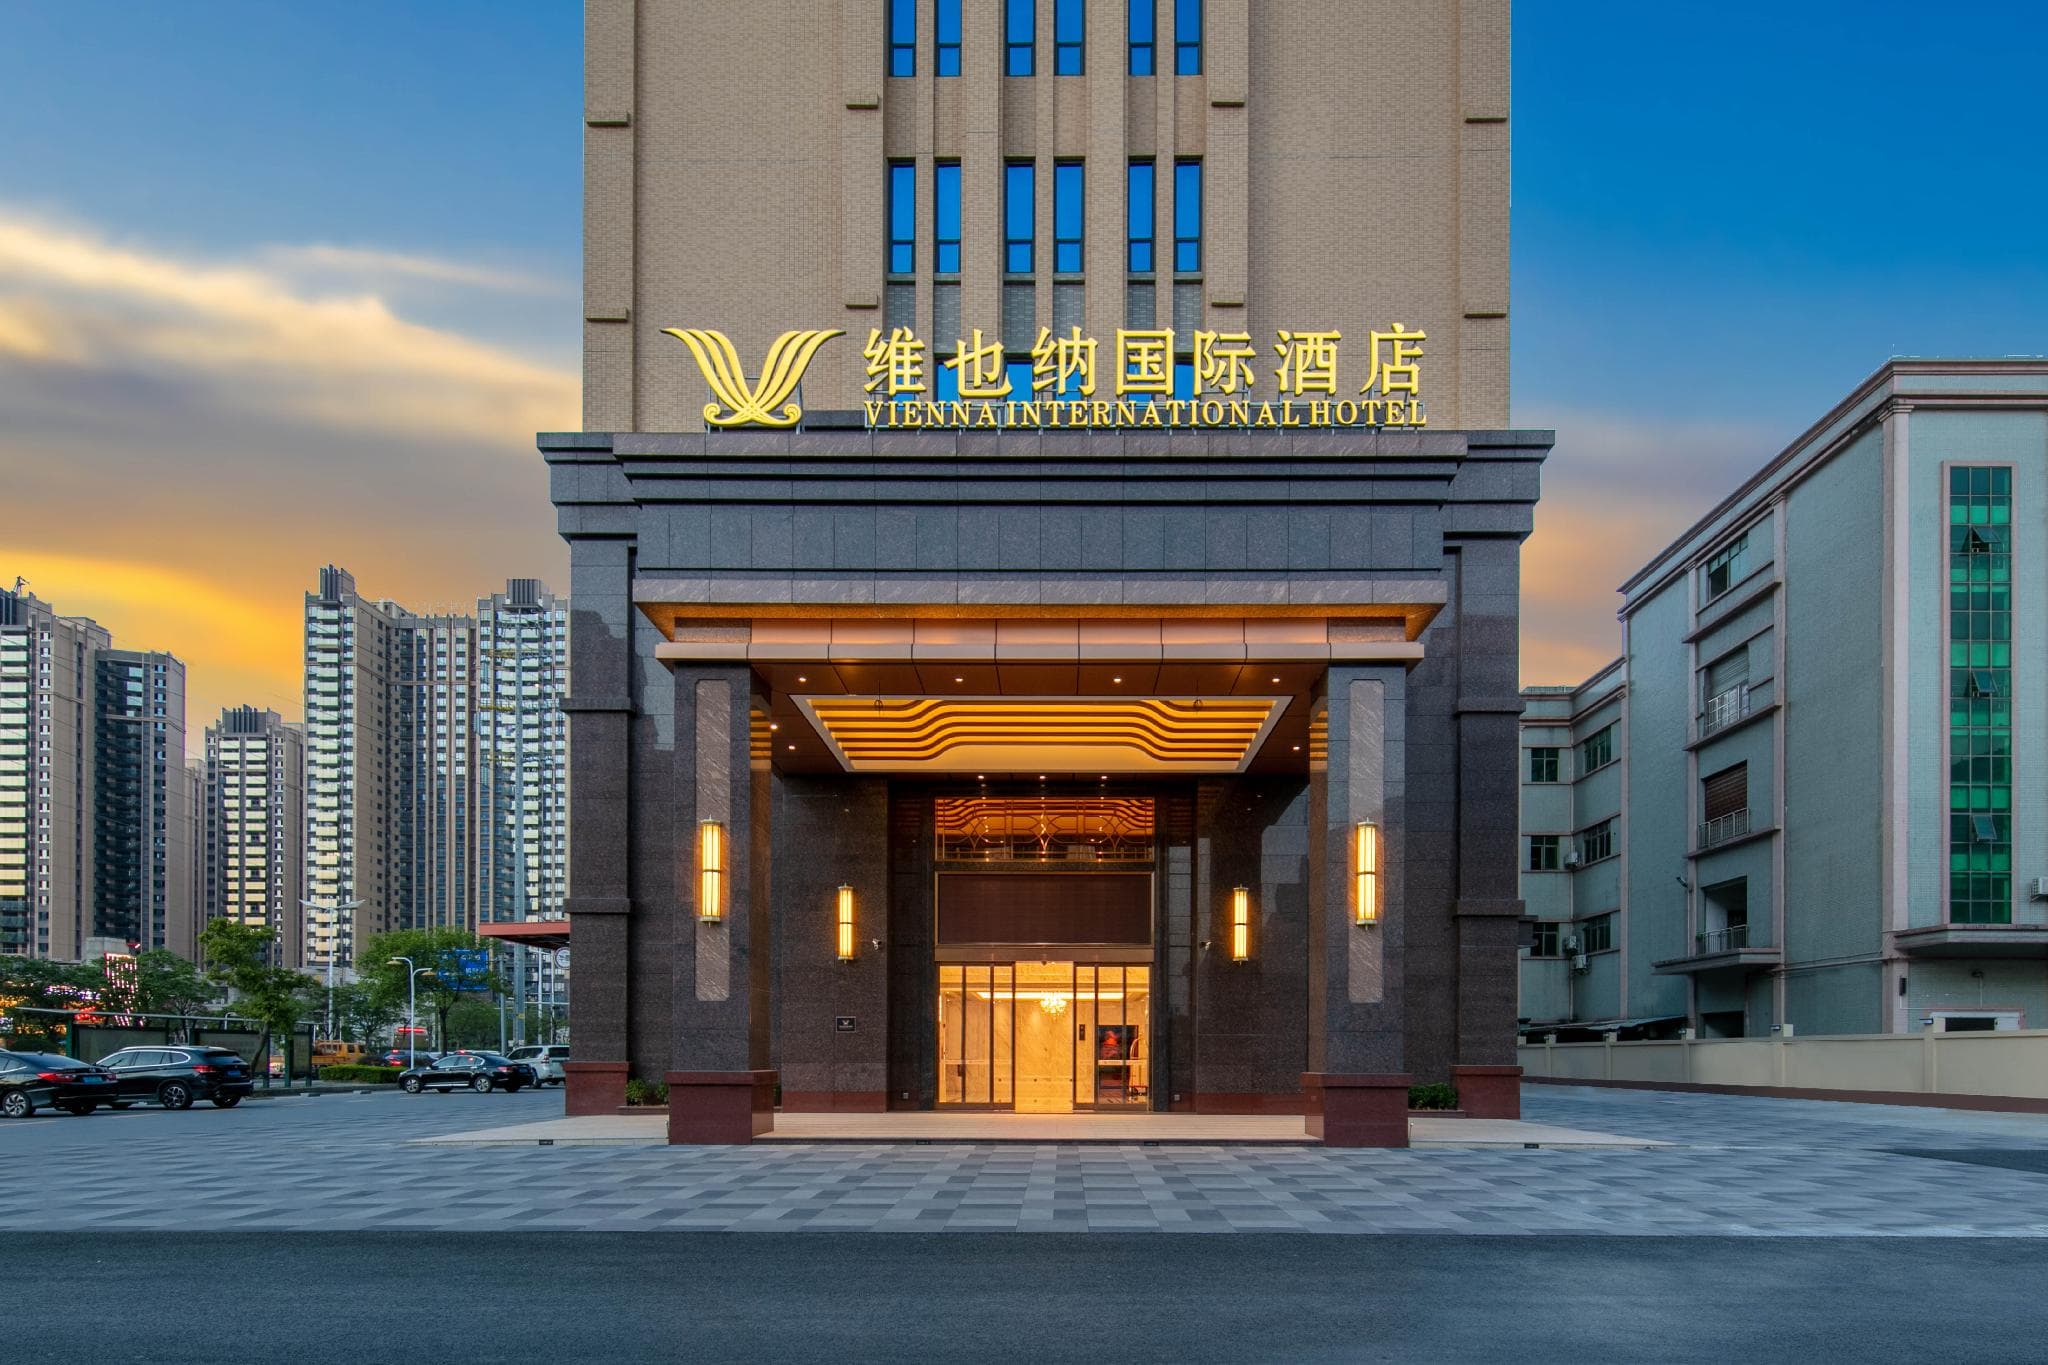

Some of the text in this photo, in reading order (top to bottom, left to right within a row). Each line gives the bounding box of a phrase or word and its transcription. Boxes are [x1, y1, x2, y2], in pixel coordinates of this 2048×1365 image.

[863, 322, 1427, 397] 维也纳国际酒店
[863, 399, 1427, 427] VIENNA INTERNATIONAL HOTEL
